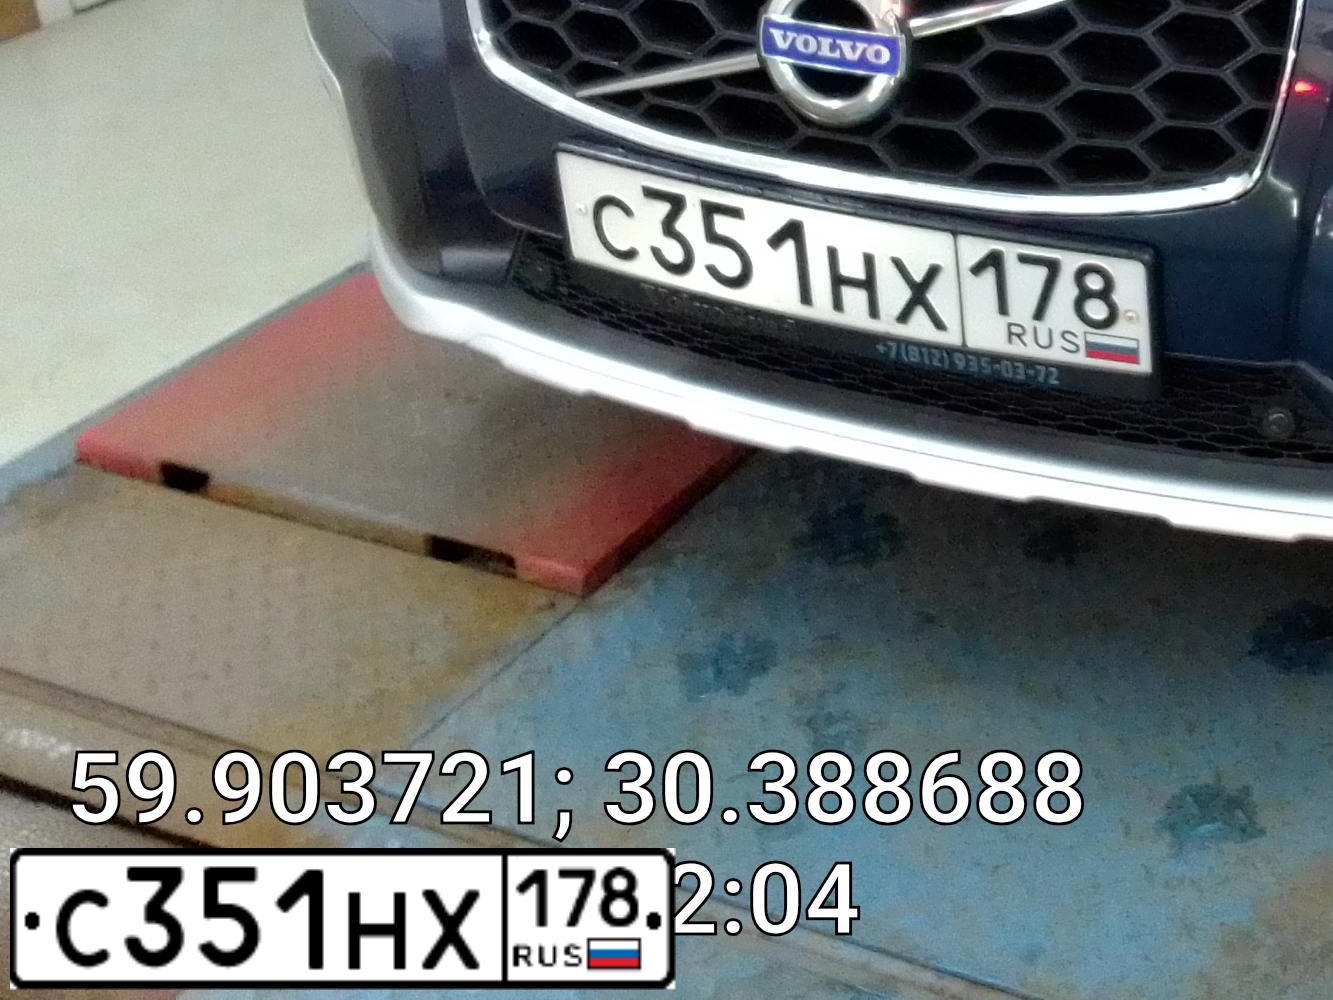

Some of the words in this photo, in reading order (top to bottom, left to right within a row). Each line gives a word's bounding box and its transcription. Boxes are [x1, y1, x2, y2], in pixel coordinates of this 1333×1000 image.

[768, 27, 891, 65] VOLVO
[969, 248, 1120, 330] 178
[1007, 321, 1081, 355] RUS
